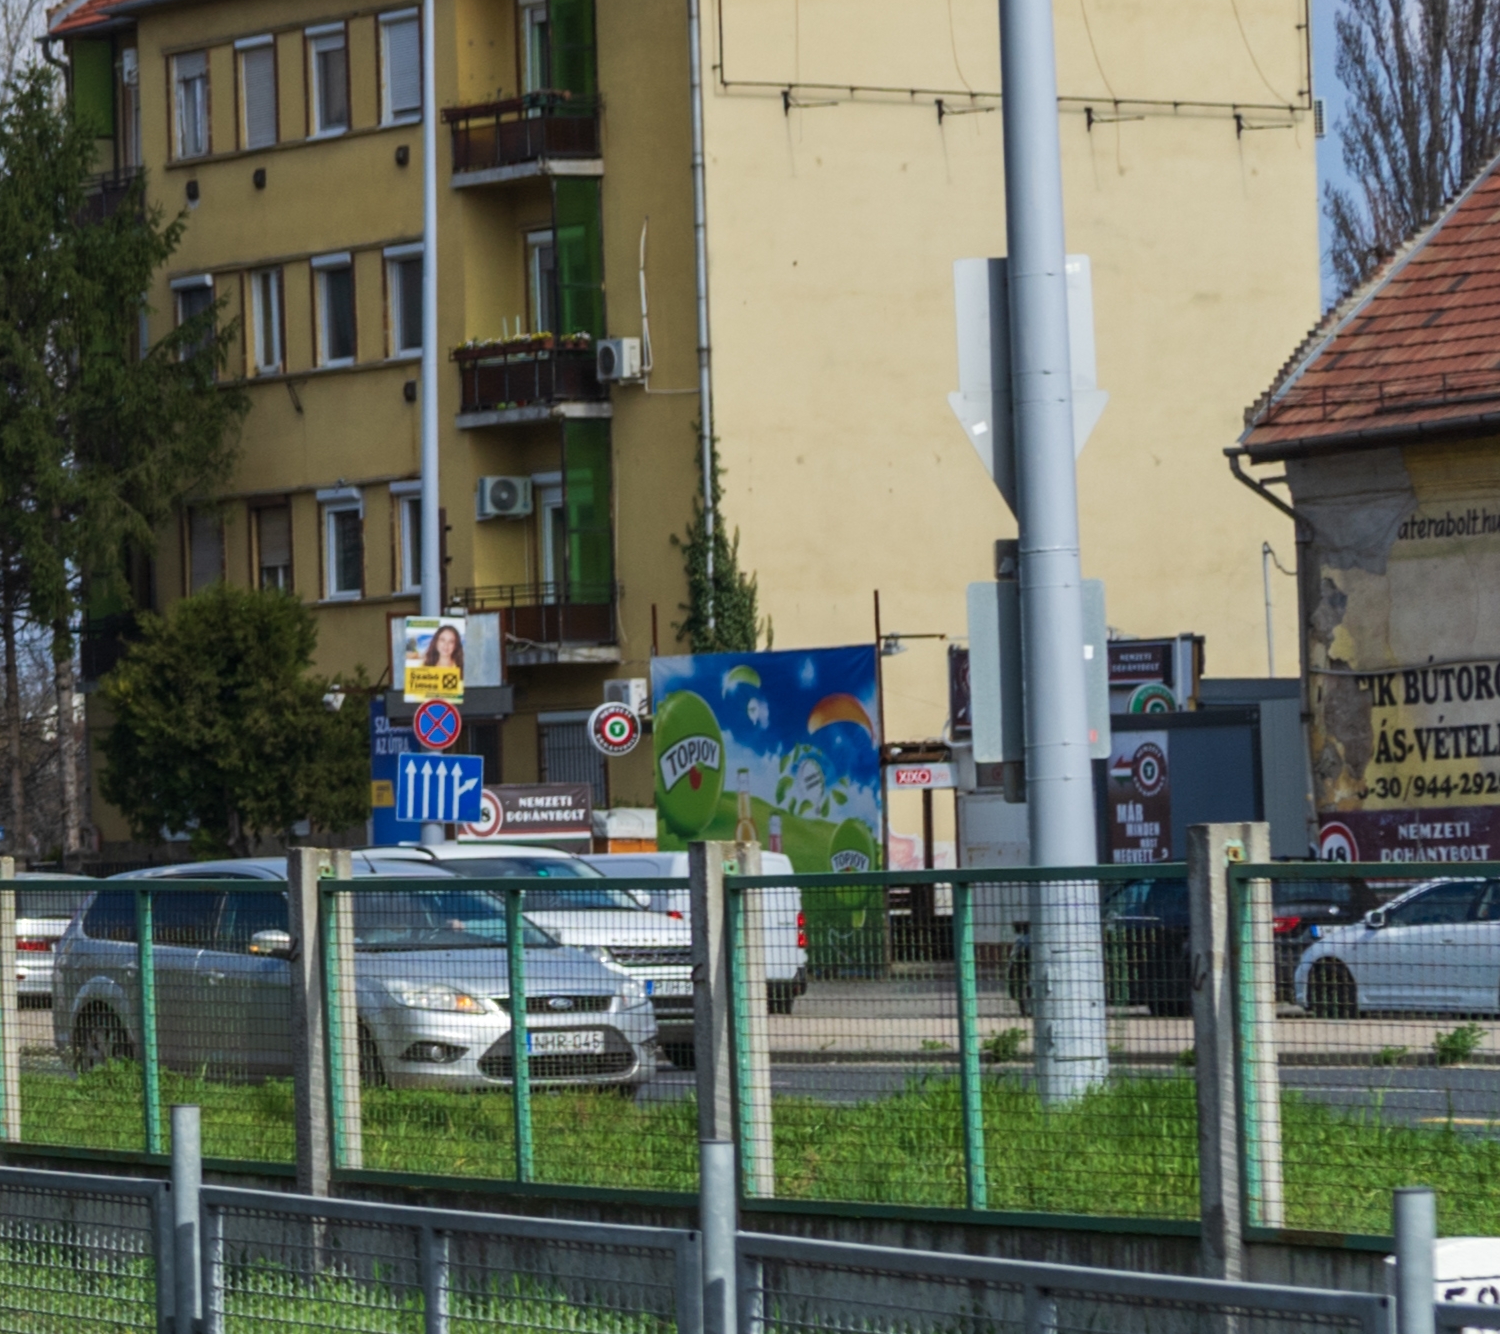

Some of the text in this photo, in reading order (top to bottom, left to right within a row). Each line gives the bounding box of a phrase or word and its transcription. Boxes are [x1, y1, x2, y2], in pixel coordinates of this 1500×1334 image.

[1374, 715, 1500, 764] ÁS-VÉTEL
[666, 739, 717, 776] TOPJOY
[899, 770, 930, 783] XIXO
[1357, 772, 1500, 802] -30/944-292
[519, 795, 572, 807] NEMZETI
[506, 808, 585, 822] DOHÁNYBOLT
[1398, 821, 1470, 839] NEMZETI
[833, 854, 866, 869] TOPJOY
[1381, 845, 1490, 862] DOHÁNYBOLT
